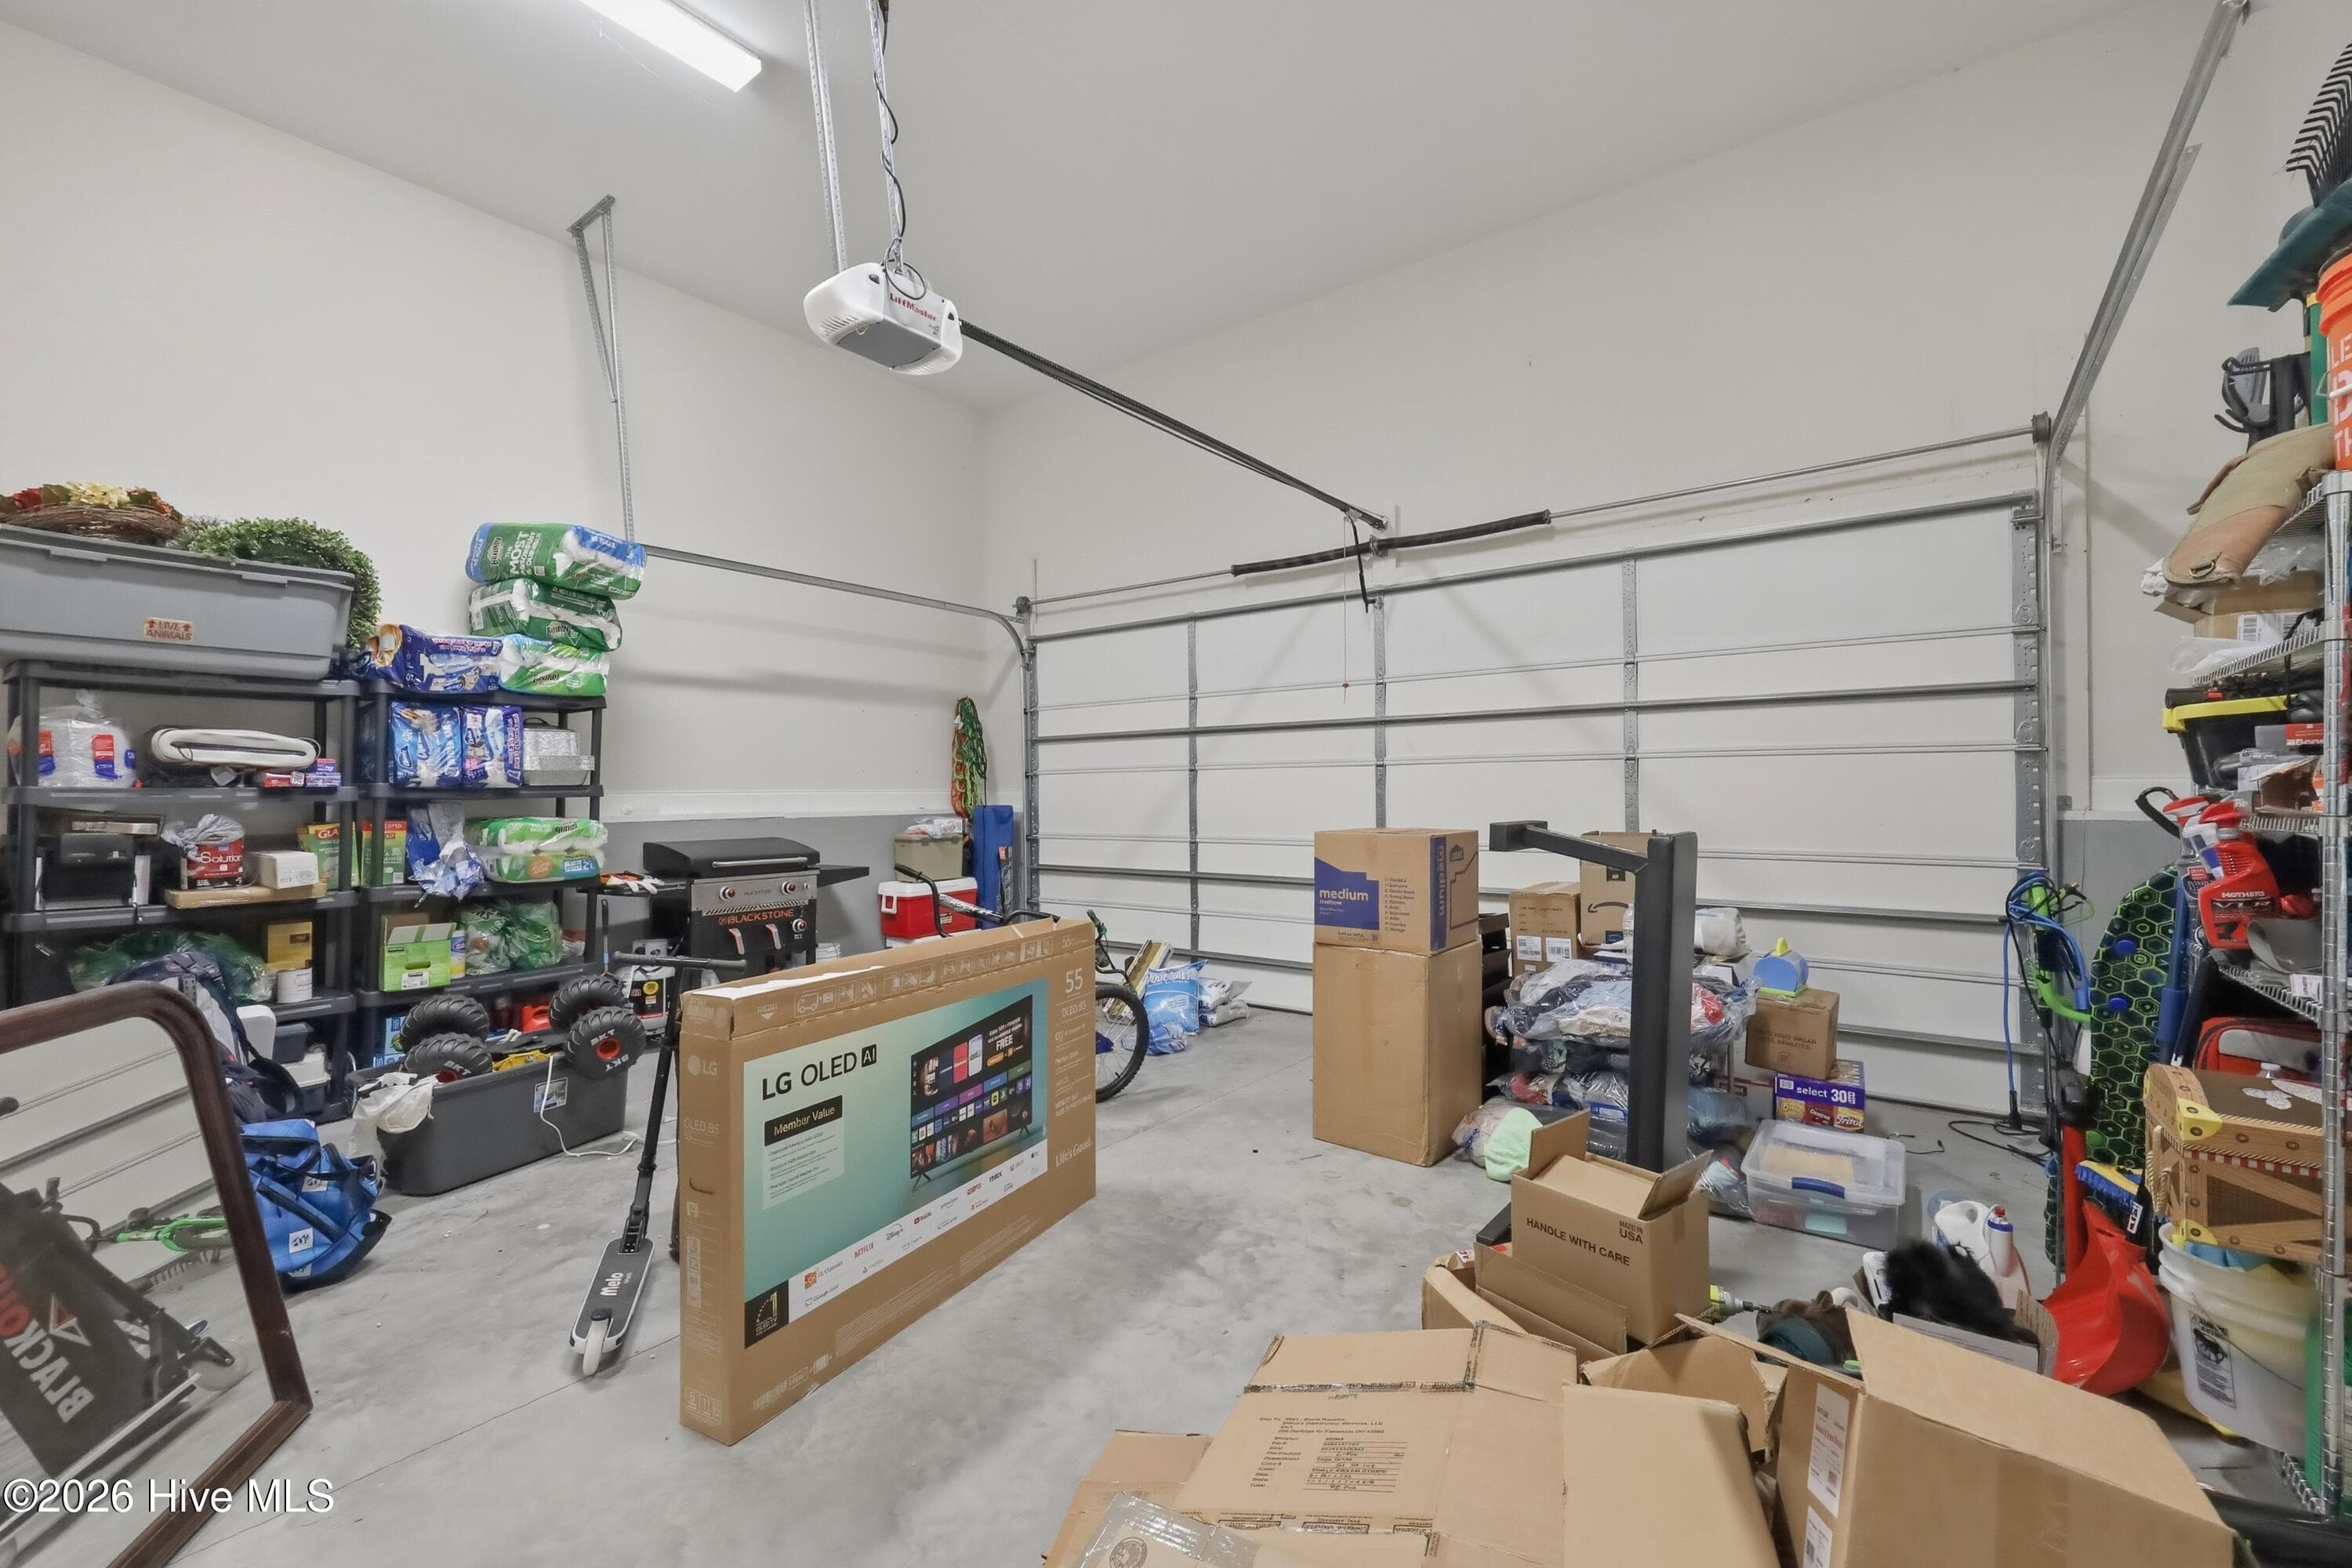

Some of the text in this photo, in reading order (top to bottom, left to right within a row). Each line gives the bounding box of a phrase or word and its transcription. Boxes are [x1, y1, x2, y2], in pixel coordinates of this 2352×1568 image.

[890, 292, 938, 321] LiftMaster
[510, 531, 529, 575] MOST
[159, 621, 180, 631] LIVE
[146, 630, 192, 641] ANIMALS
[318, 829, 339, 840] GLA
[1438, 844, 1446, 916] medium
[1319, 888, 1369, 902] medium
[2221, 890, 2265, 898] MOTHERS
[728, 909, 795, 924] BLACKSTONE
[1065, 967, 1083, 993] 55
[1062, 1004, 1078, 1018] OLED
[996, 1034, 1013, 1051] FREE
[762, 1047, 877, 1101] LG OLED AI
[1796, 1087, 1847, 1103] select 30
[684, 1117, 706, 1131] OLED
[774, 1105, 835, 1136] Member Value
[1837, 1115, 1863, 1127] Fritos
[1526, 1217, 1631, 1267] HANDLE WITH CARE
[1620, 1229, 1644, 1245] USA
[601, 1272, 624, 1296] Melo
